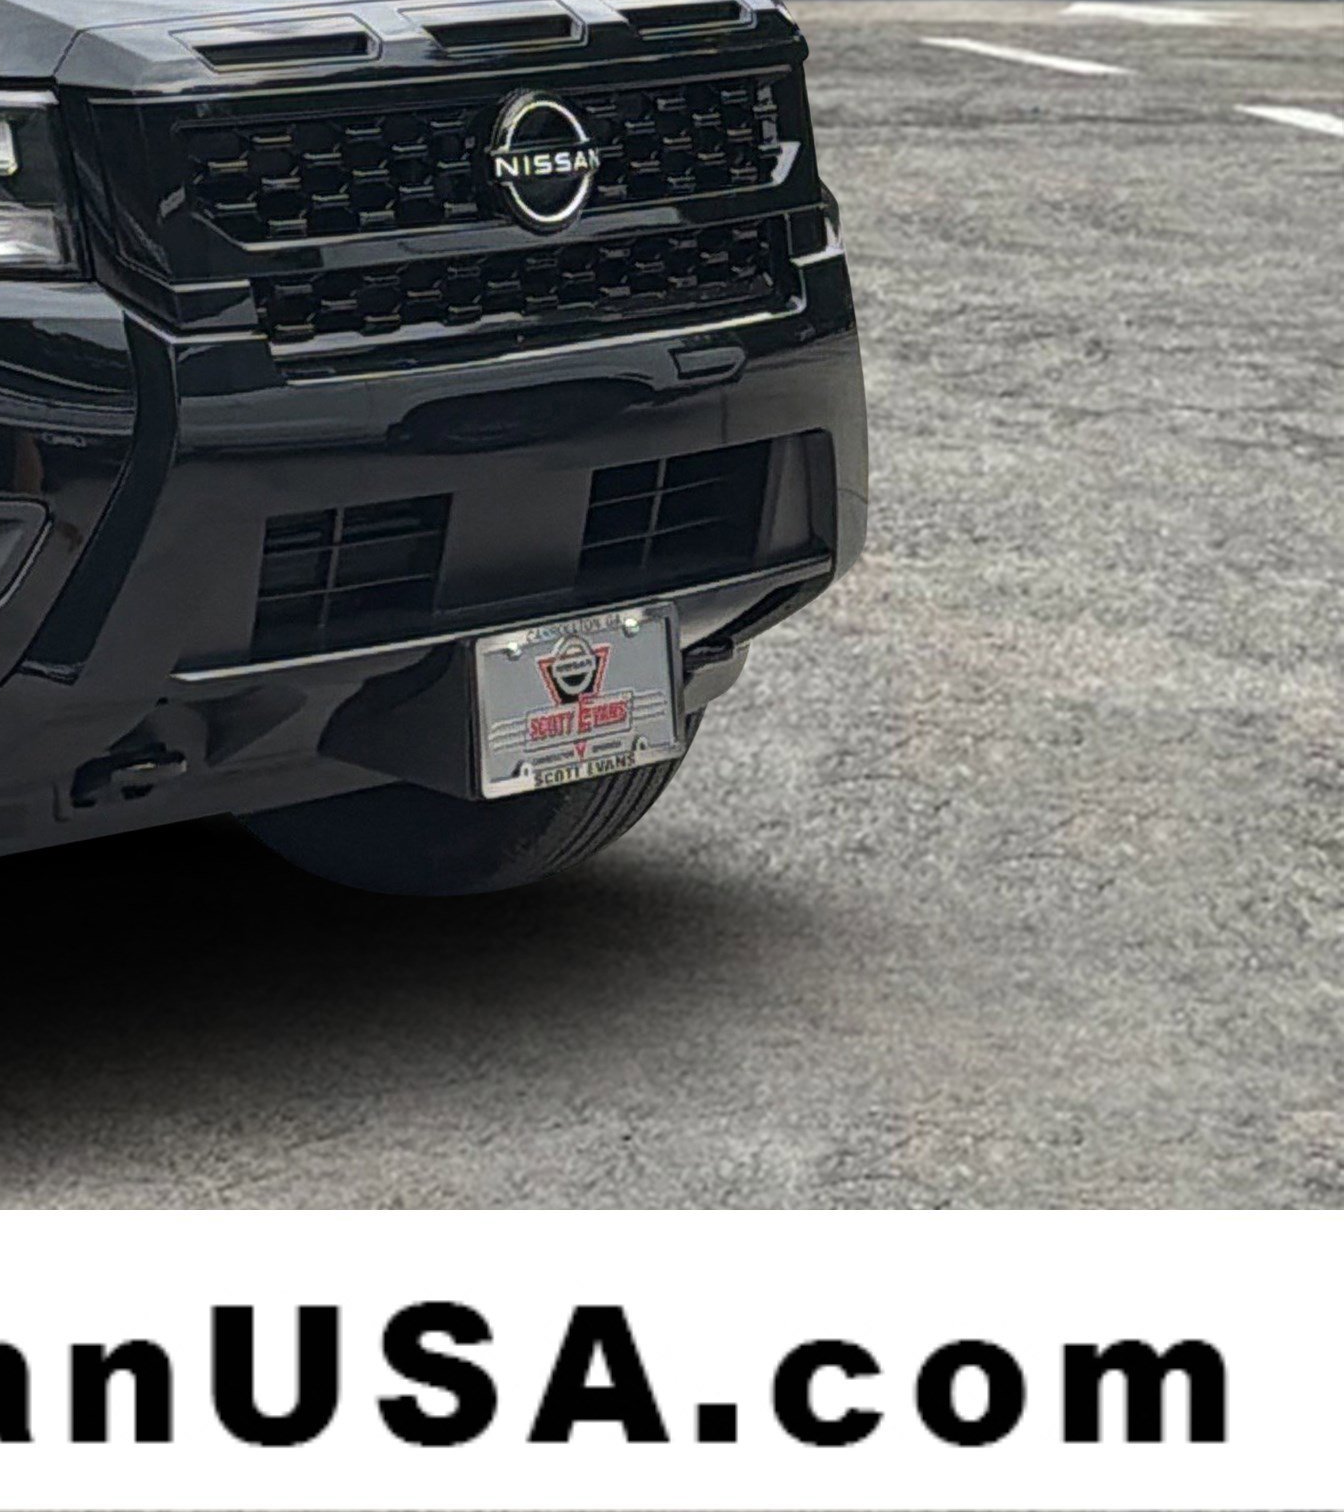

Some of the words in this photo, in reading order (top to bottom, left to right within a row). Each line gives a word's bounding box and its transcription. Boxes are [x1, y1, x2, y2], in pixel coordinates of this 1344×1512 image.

[495, 147, 602, 178] NISSAN
[529, 710, 575, 741] SCOTT
[534, 764, 580, 787] SCOTT
[587, 751, 636, 777] EVANS
